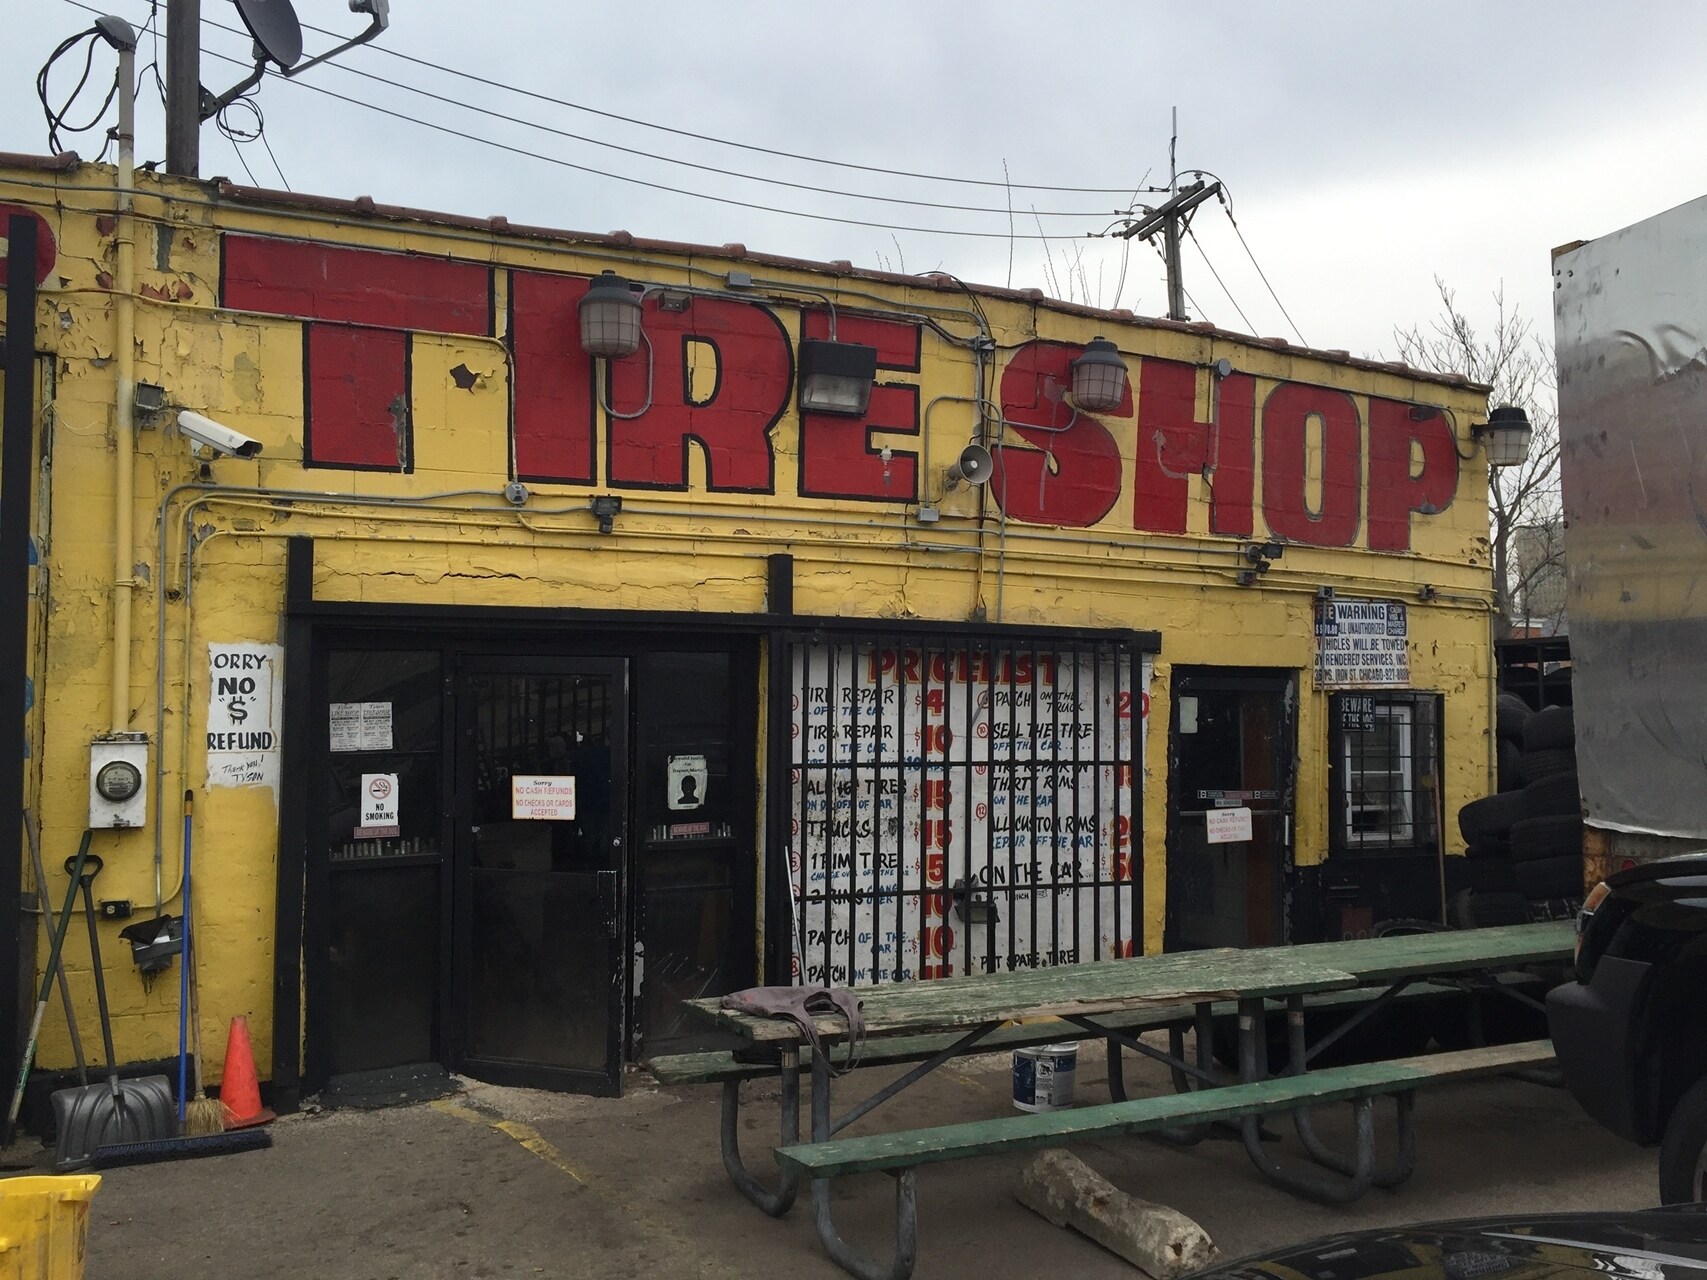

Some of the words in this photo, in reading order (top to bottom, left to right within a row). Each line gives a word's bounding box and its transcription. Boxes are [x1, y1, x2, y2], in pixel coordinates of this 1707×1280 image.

[219, 231, 920, 503] TIRE
[991, 341, 1460, 551] SHOP
[1316, 606, 1334, 619] FE
[1337, 605, 1385, 620] WARNING
[1347, 622, 1385, 635] UNAUTHORIZED
[1317, 638, 1351, 651] VHICLES
[1353, 638, 1369, 651] WILL
[1370, 639, 1380, 651] BE
[1381, 638, 1406, 651] TOWED
[1314, 653, 1323, 666] BY
[1325, 653, 1360, 666] RENDERED
[217, 677, 256, 696] NO
[801, 687, 830, 703] IR
[841, 687, 894, 704] REPAR
[995, 690, 1031, 708] PACH
[1341, 697, 1373, 713] BEWARE
[841, 724, 893, 739] REPAR
[993, 723, 1024, 741] SEL
[206, 731, 272, 750] REFUND
[1024, 760, 1070, 774] REPAR
[231, 772, 264, 783] TYSON
[533, 779, 553, 787] Sorry
[993, 775, 1040, 791] THRT
[1043, 775, 1077, 790] RMS
[515, 787, 525, 795] NO
[525, 787, 543, 795] CASH
[543, 787, 573, 796] REFUNDS
[806, 779, 829, 796] AL
[864, 779, 907, 796] TRES
[375, 802, 385, 811] NO
[515, 799, 524, 807] NO
[524, 799, 546, 808] CHECKS
[545, 799, 554, 808] OR
[554, 799, 573, 808] CARDS
[876, 799, 893, 810] AR
[1011, 795, 1030, 806] HE
[365, 812, 394, 821] SMOKING
[530, 808, 558, 817] ACCEPTED
[1015, 815, 1062, 834] CUTO
[1065, 815, 1097, 834] RMS
[1030, 836, 1047, 848] FF
[1071, 835, 1093, 847] AR
[858, 852, 899, 870] TRE
[810, 869, 840, 882] CHAGE
[870, 943, 892, 955] AR
[980, 954, 1002, 971] PT
[1046, 950, 1078, 967] TRE
[892, 968, 912, 981] CR
